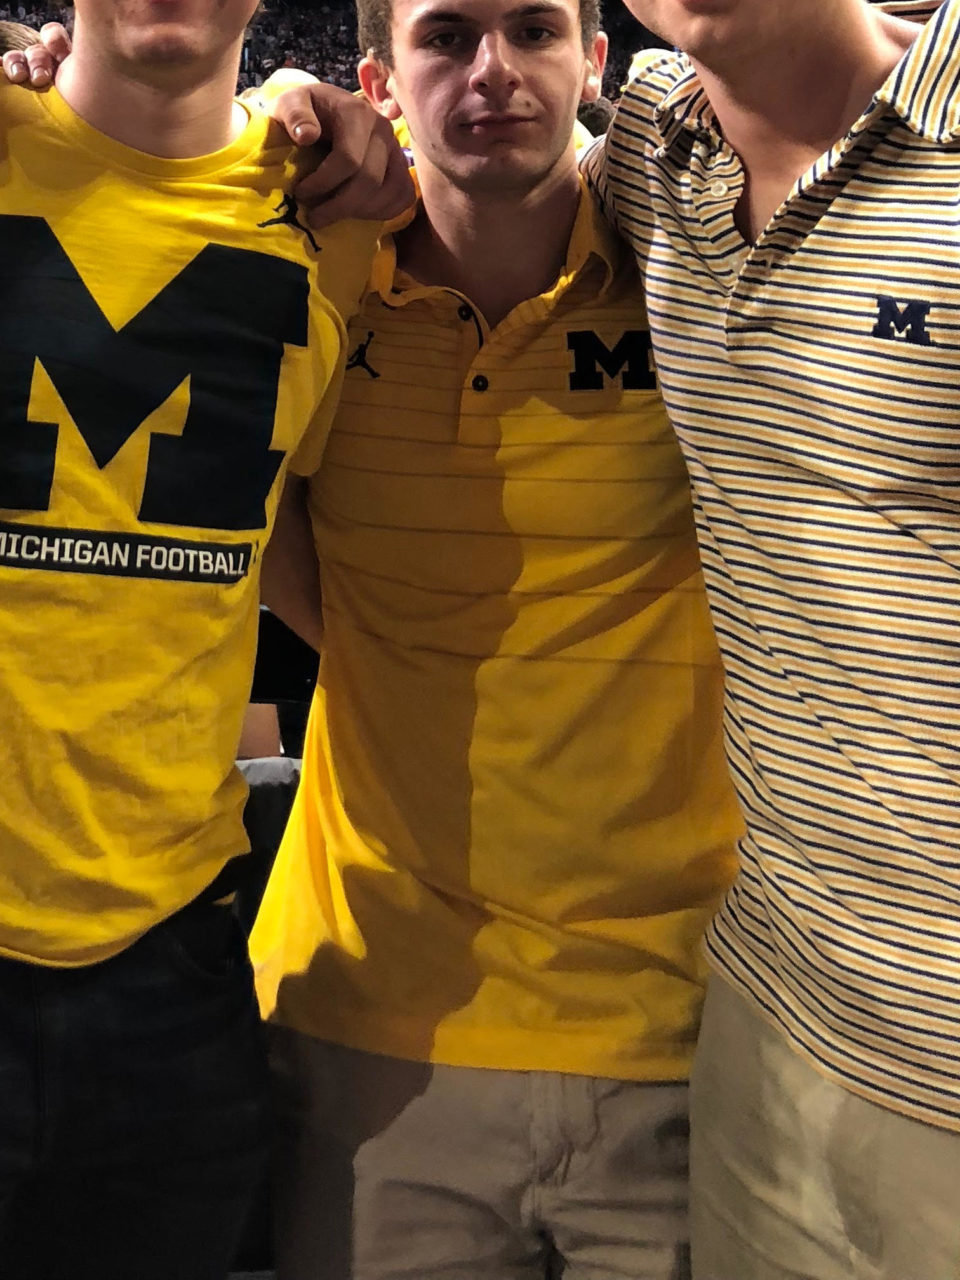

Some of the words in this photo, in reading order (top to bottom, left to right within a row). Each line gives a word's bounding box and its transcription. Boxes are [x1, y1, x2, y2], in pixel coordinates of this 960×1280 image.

[872, 294, 933, 346] M
[566, 330, 658, 390] M
[136, 544, 246, 576] FOOTBALL
